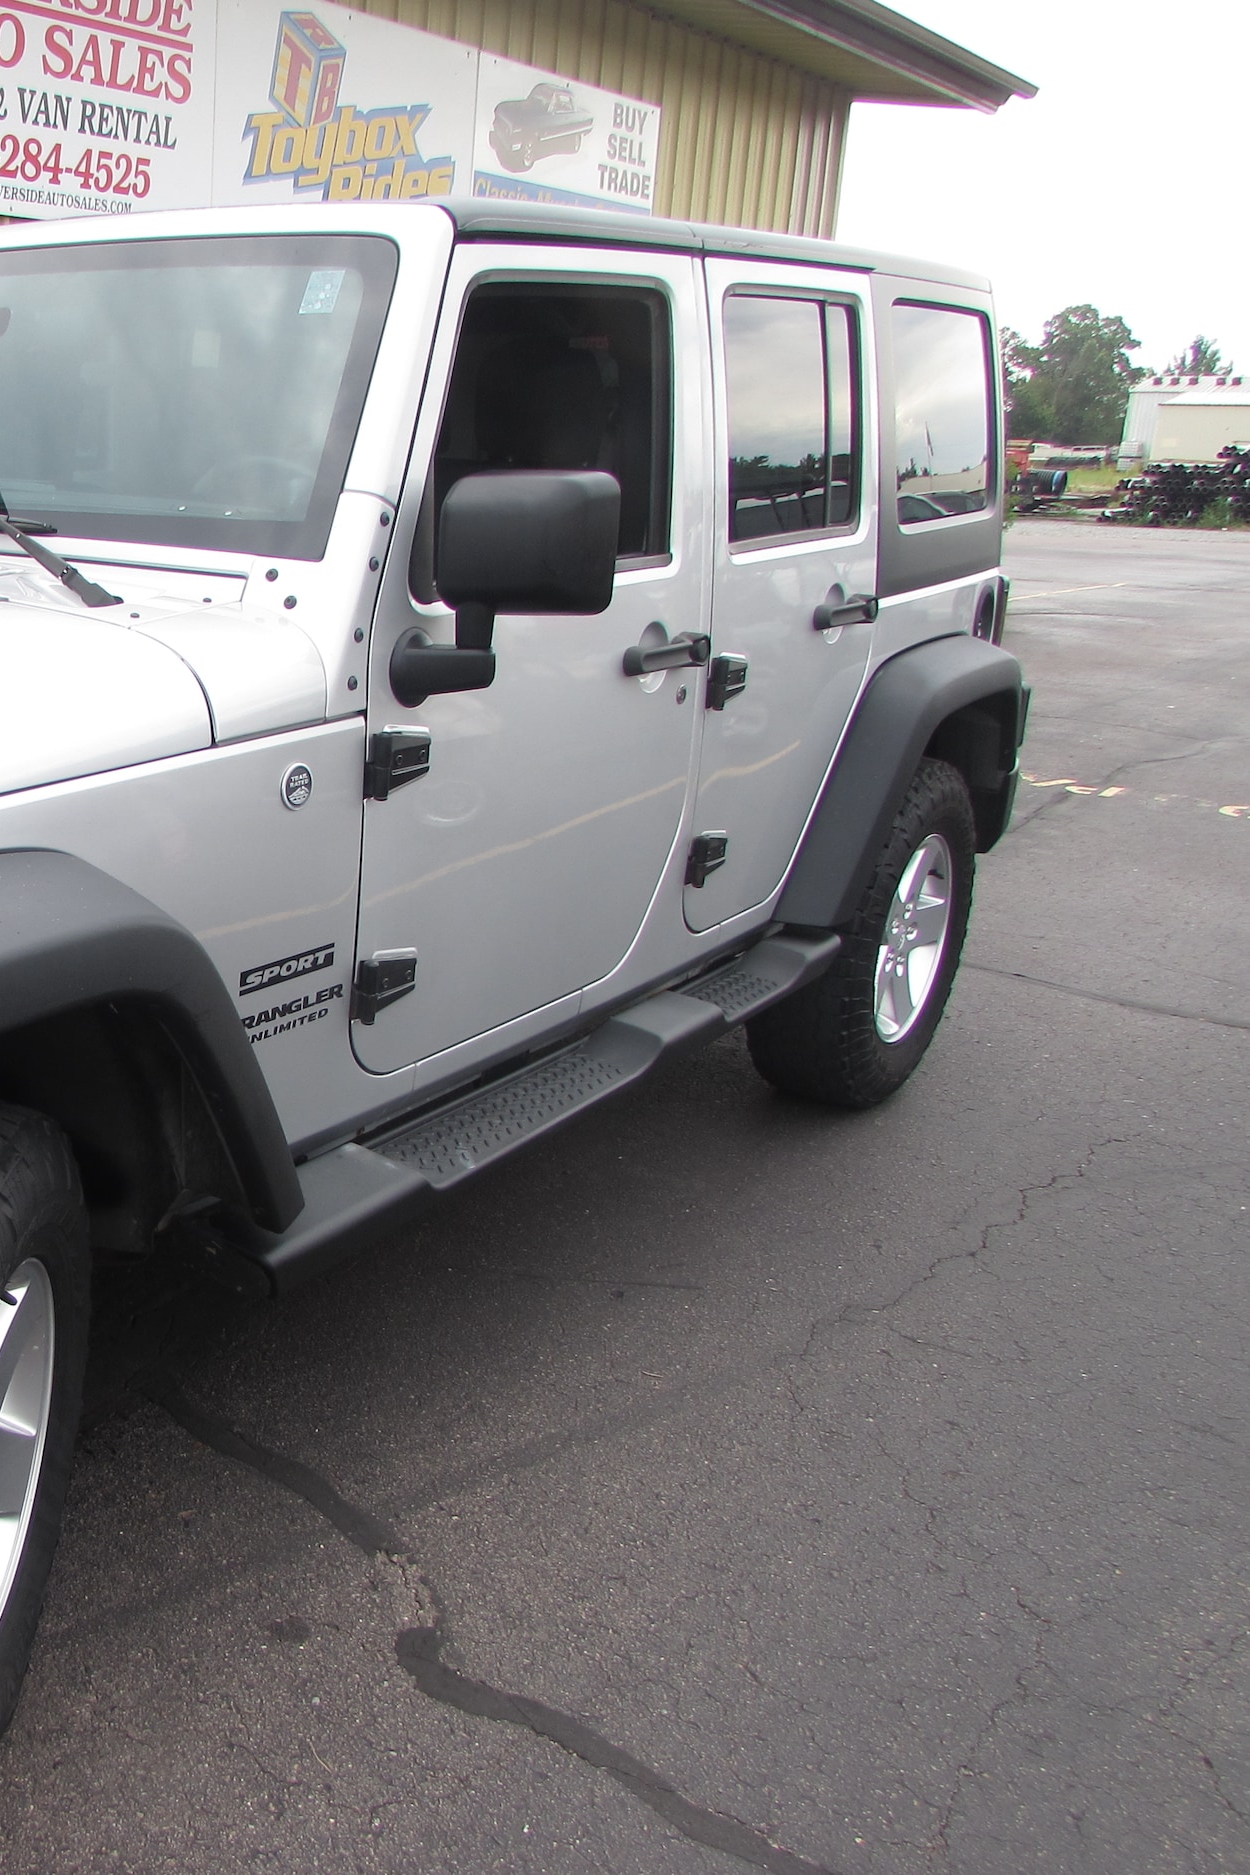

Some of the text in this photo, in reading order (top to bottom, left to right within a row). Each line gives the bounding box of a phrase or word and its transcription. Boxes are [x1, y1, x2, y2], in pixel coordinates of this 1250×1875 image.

[42, 24, 192, 104] SALES
[17, 87, 72, 131] VAN
[78, 99, 177, 150] RENTAL
[612, 103, 647, 135] BUY
[250, 106, 424, 187] Toybox
[607, 133, 646, 168] SELL
[597, 163, 651, 200] TRADE
[243, 951, 332, 986] SPORT
[241, 983, 344, 1030] RANGLER
[248, 1008, 329, 1044] NLIMITED
